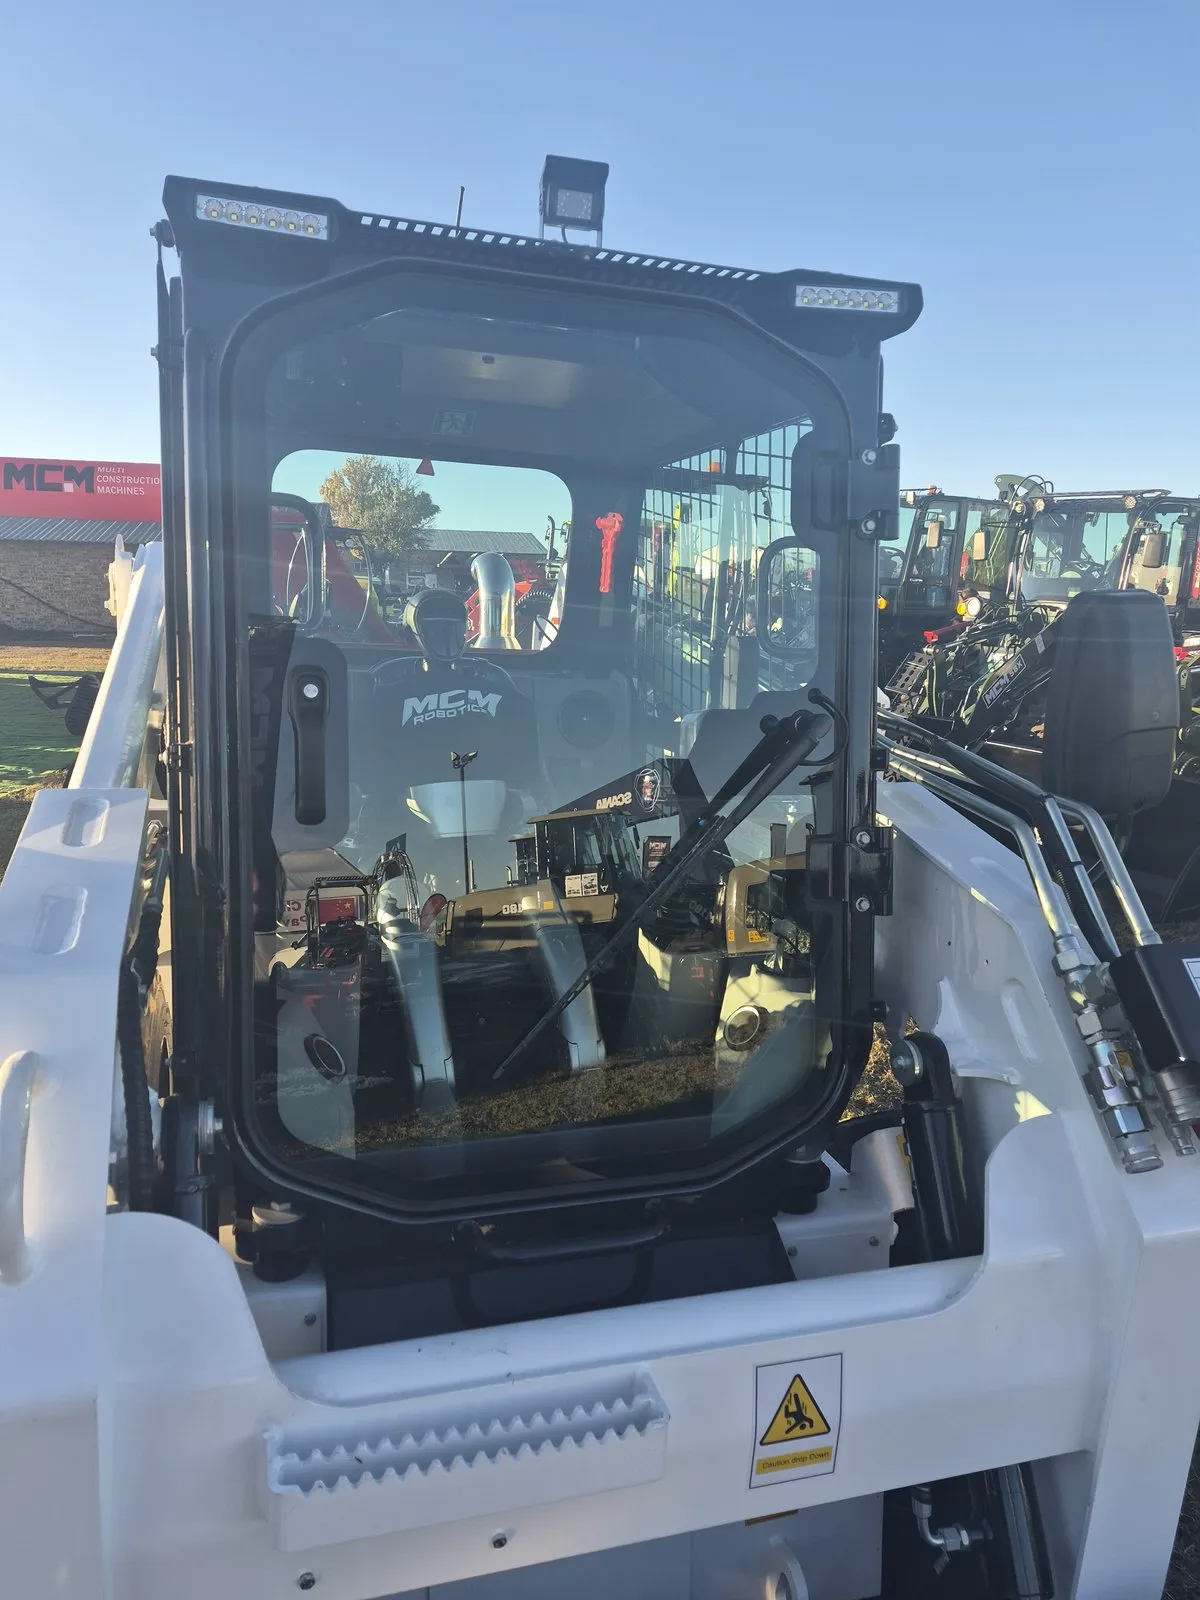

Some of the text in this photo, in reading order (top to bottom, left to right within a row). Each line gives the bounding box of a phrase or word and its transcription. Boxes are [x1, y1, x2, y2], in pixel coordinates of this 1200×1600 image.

[4, 462, 95, 494] MCM
[97, 466, 125, 474] MULTI
[97, 485, 145, 496] MACHINES
[984, 673, 1011, 705] MCM
[402, 689, 503, 728] MCM
[762, 1458, 790, 1469] Caution
[791, 1455, 808, 1464] drop
